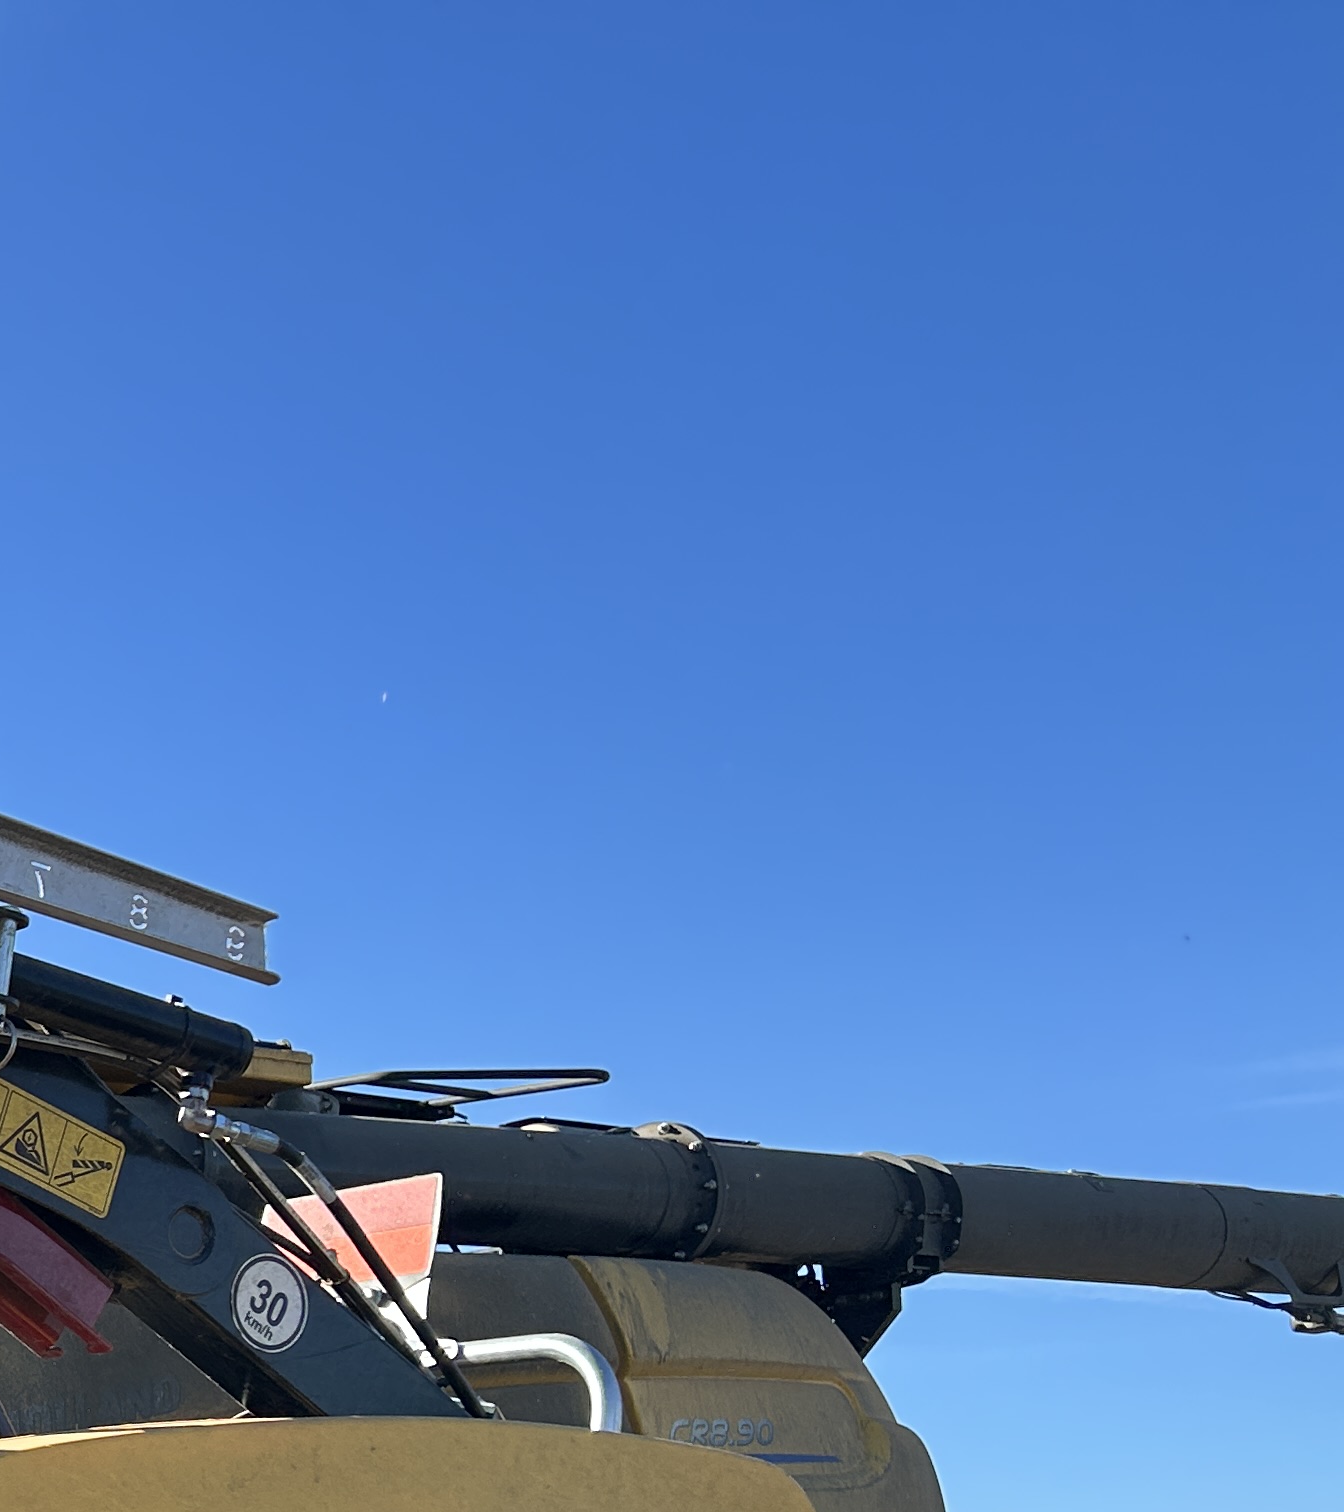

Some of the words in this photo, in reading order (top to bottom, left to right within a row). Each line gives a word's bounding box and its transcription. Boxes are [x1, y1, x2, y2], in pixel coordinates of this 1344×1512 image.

[250, 1279, 289, 1327] 30
[243, 1310, 274, 1341] km/h
[669, 1417, 774, 1447] CR8.90
